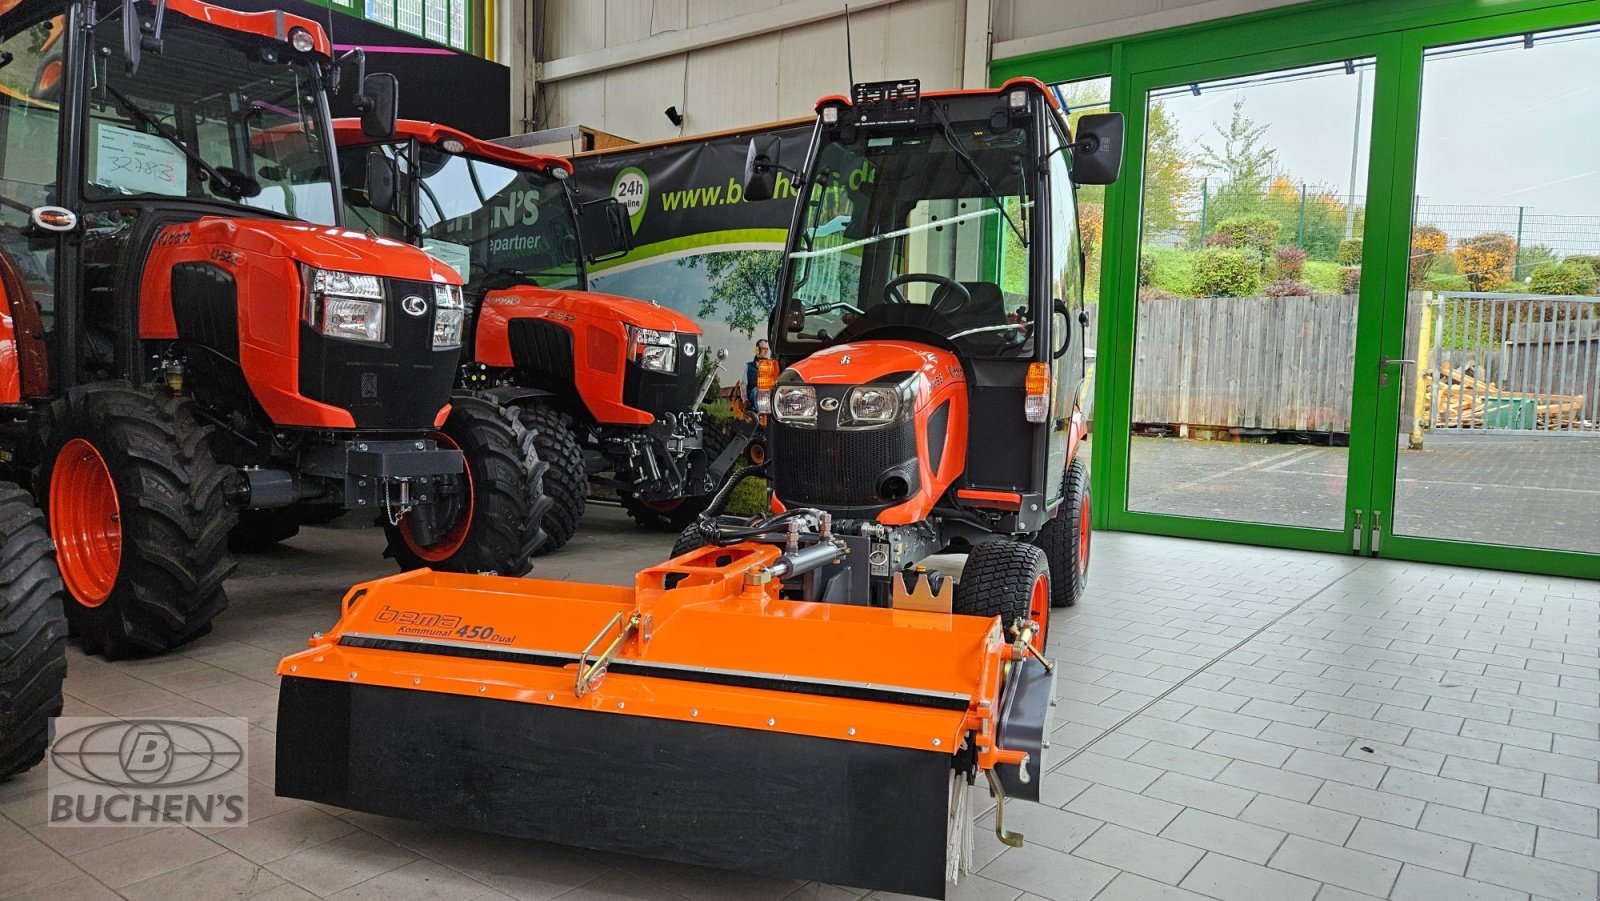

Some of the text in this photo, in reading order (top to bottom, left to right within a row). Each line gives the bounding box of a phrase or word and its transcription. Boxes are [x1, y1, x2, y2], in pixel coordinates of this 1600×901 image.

[618, 180, 643, 197] 24h
[375, 606, 462, 628] bema
[398, 625, 516, 643] Kommunal 450 Dual
